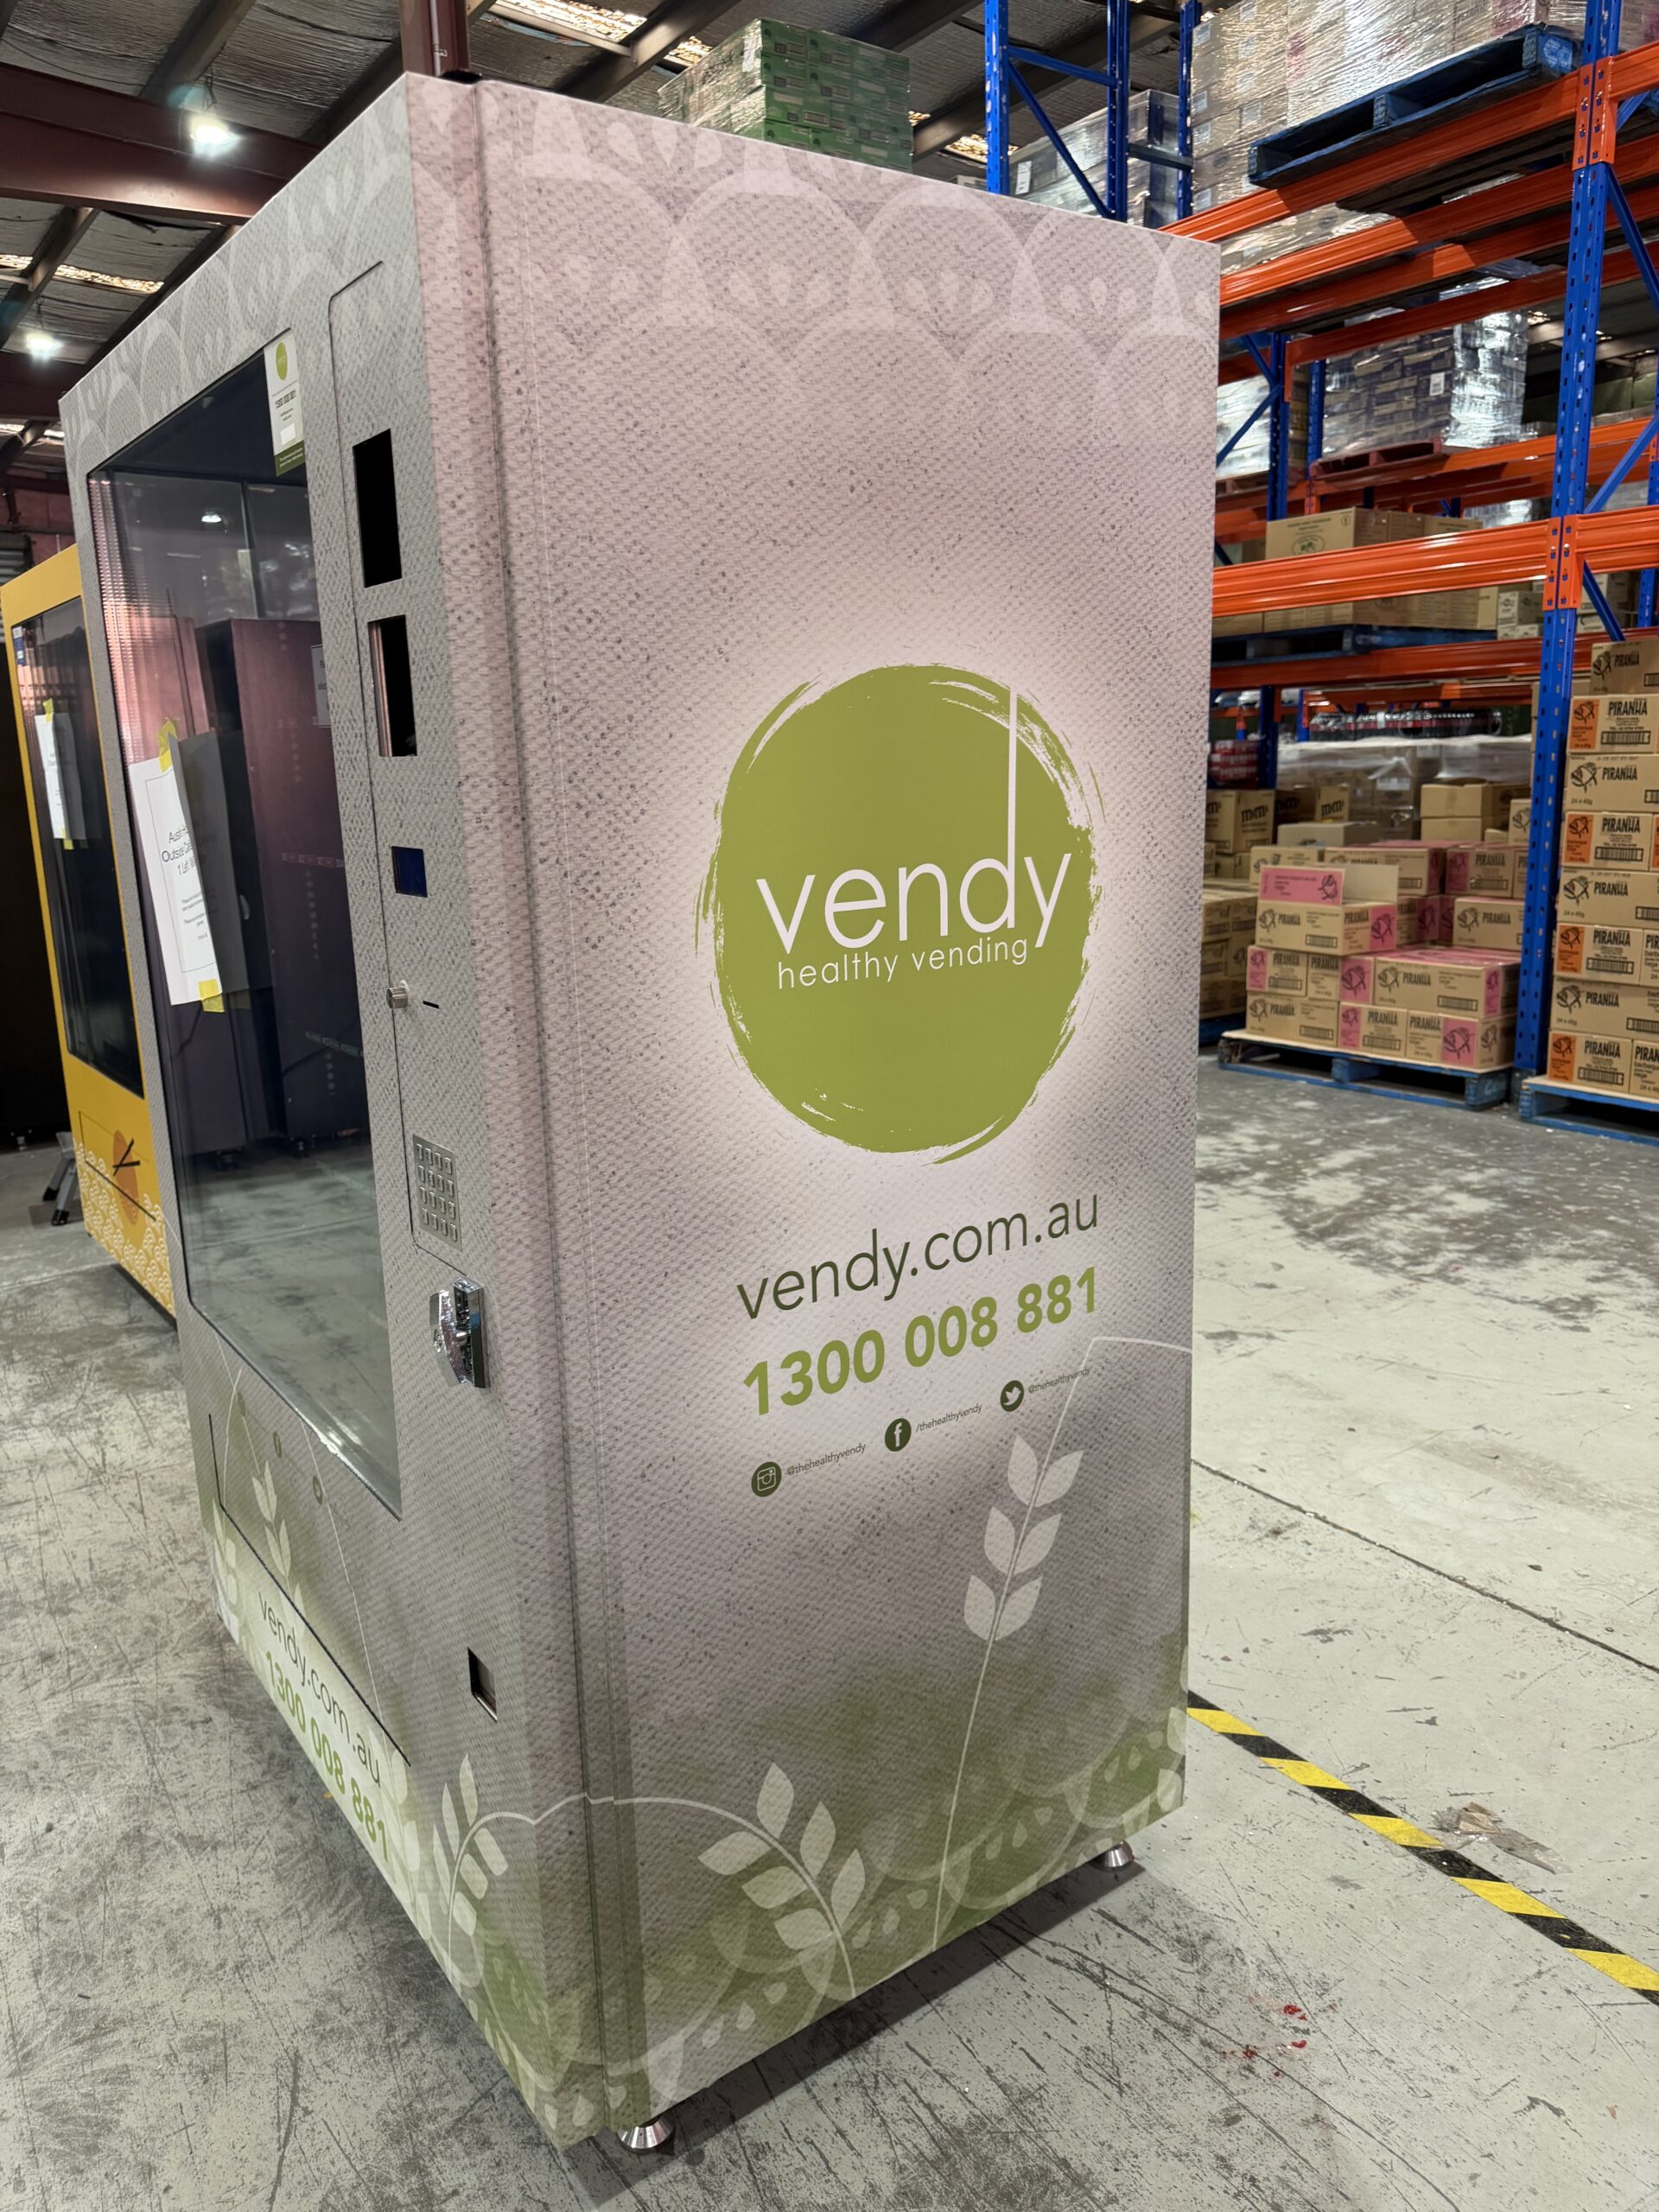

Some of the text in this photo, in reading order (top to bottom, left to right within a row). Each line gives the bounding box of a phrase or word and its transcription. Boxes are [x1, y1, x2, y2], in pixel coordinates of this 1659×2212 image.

[1608, 699, 1648, 716] PIRANHA
[1601, 766, 1638, 782] PIRANHA
[755, 690, 1071, 955] vendy
[1602, 817, 1641, 834] PIRANHA
[1593, 880, 1629, 897] PIRANHA
[1482, 912, 1511, 925] PIRANHA
[1592, 930, 1631, 947] PIRANHA
[777, 935, 1028, 989] healthy vending
[1402, 971, 1432, 987] PIRANHA
[1586, 990, 1620, 1007] PIRANHA
[1367, 1010, 1398, 1027] PIRANHA
[1409, 1015, 1441, 1032] PIRANHA
[1584, 1039, 1621, 1058] PIRANHA
[736, 1194, 1098, 1320] vendy.com.au
[742, 1266, 1096, 1416] 1300 008 881
[785, 1442, 867, 1477] @thehealthyvendy
[258, 1591, 381, 1789] vendy.com.au
[265, 1650, 389, 1864] 1300 008 881
